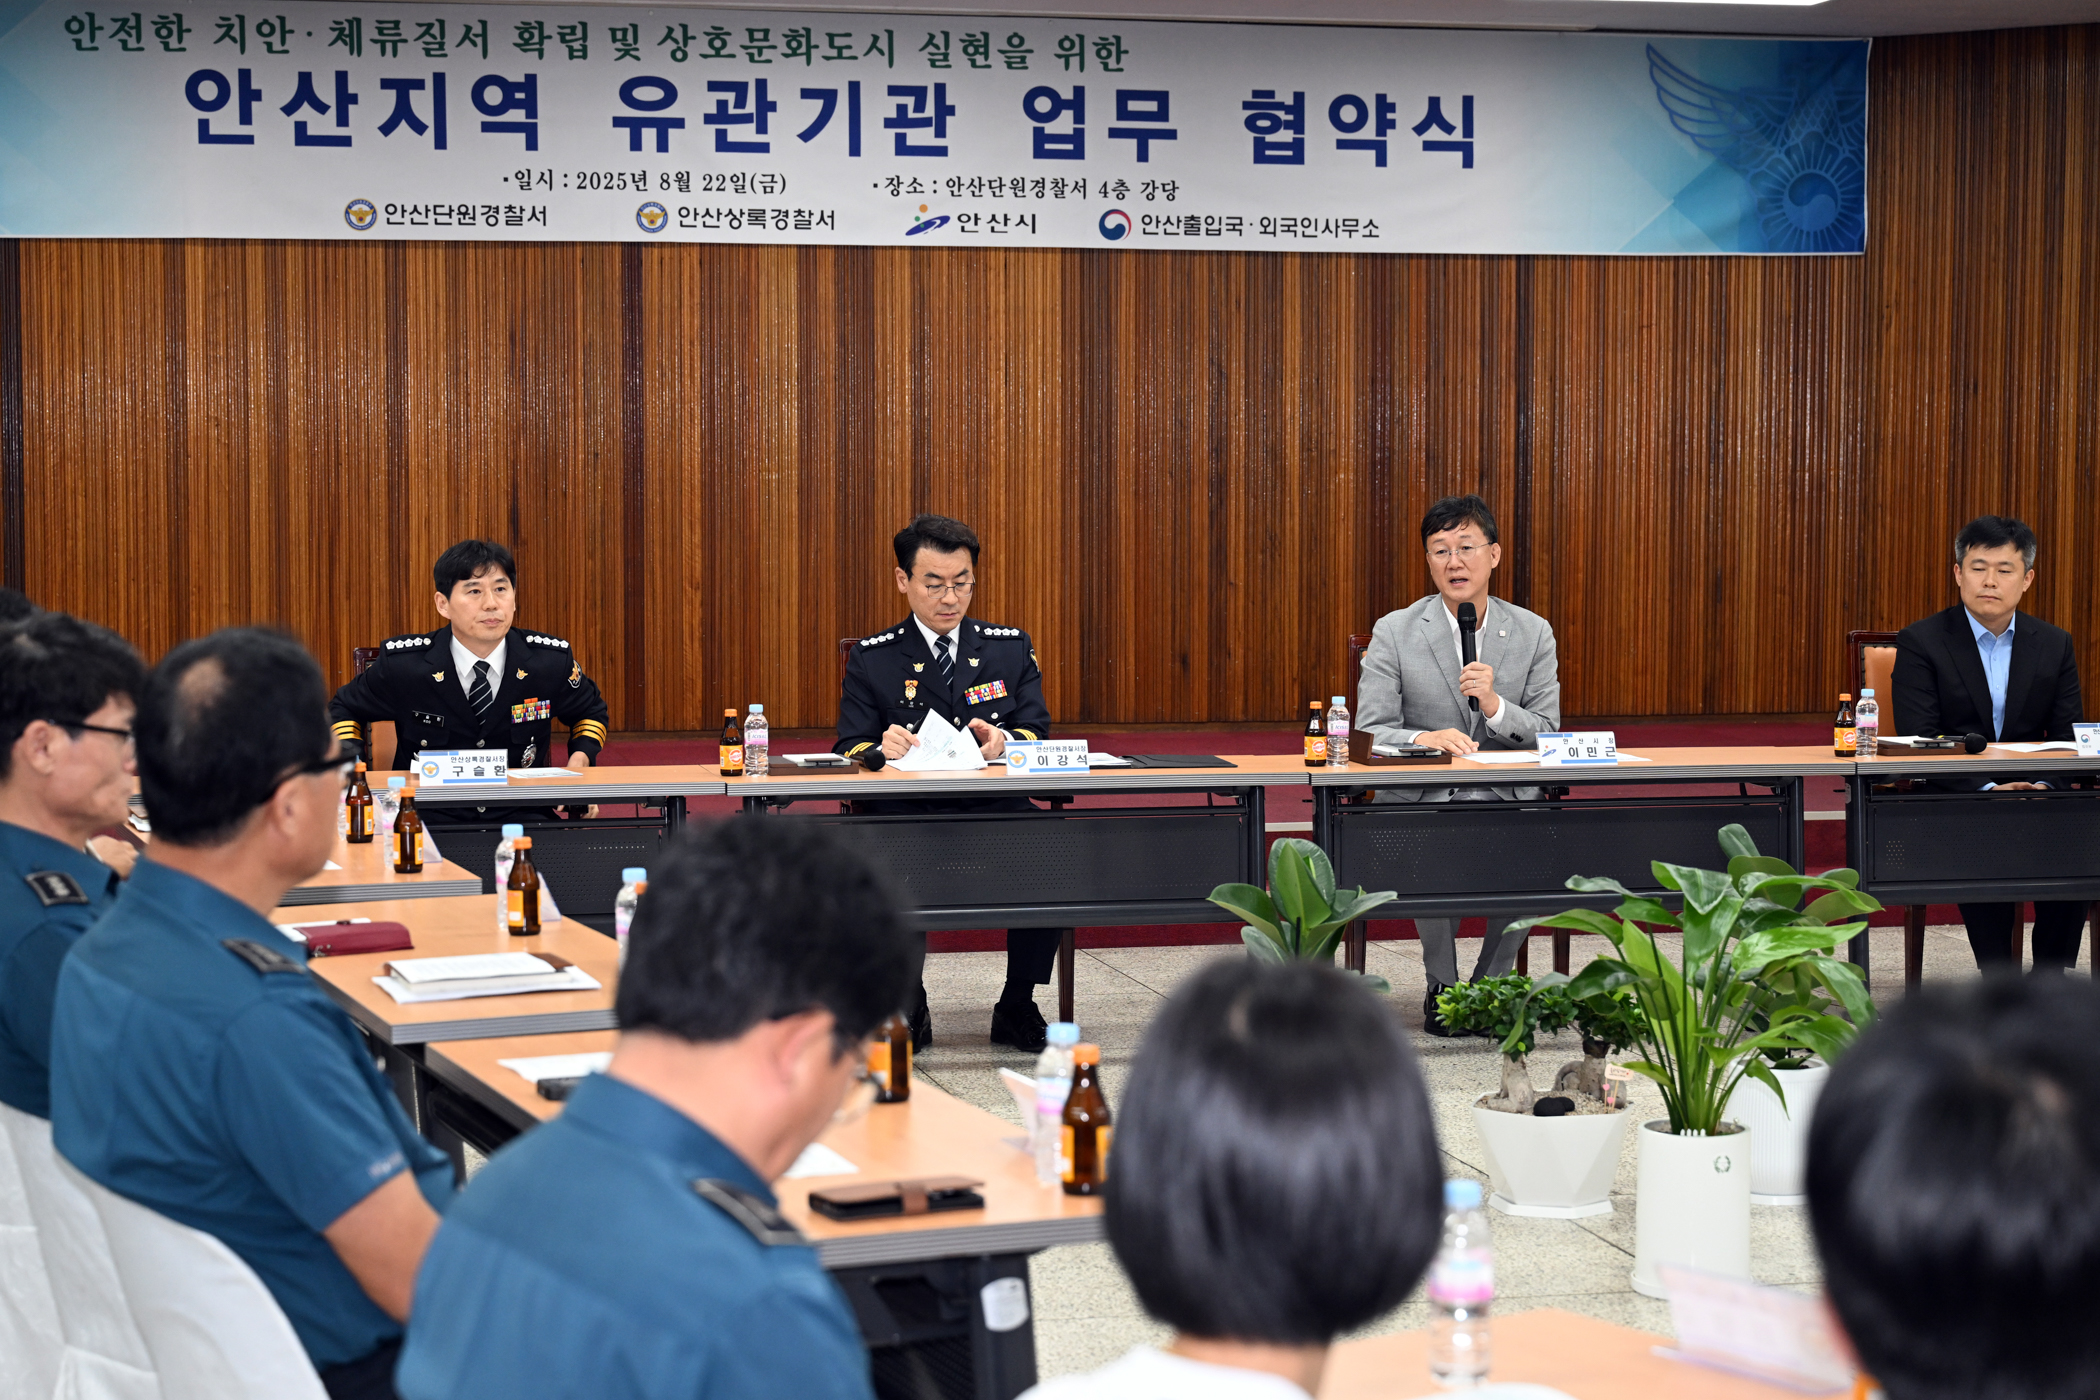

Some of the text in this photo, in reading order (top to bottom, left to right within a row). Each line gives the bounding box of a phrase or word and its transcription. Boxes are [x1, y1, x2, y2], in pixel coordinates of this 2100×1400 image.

[65, 12, 192, 53] 안전한
[513, 21, 589, 60] 확립
[608, 23, 641, 62] 및
[657, 24, 894, 69] 상호문화도시
[919, 31, 1034, 71] 실현을
[1054, 34, 1130, 73] 위한
[185, 69, 1475, 170] 안산지역 유관기관 업무 협약식
[577, 171, 649, 192] 2025년
[660, 171, 691, 193] 8월
[703, 173, 788, 195] 22일(금)
[945, 176, 1087, 201] 안산단원경찰서
[1099, 179, 1131, 201] 4층
[1141, 180, 1180, 202] 강당
[385, 203, 547, 228] 안산단원경찰서
[678, 207, 835, 231] 안산상록경찰서
[957, 213, 1037, 235] 안산시
